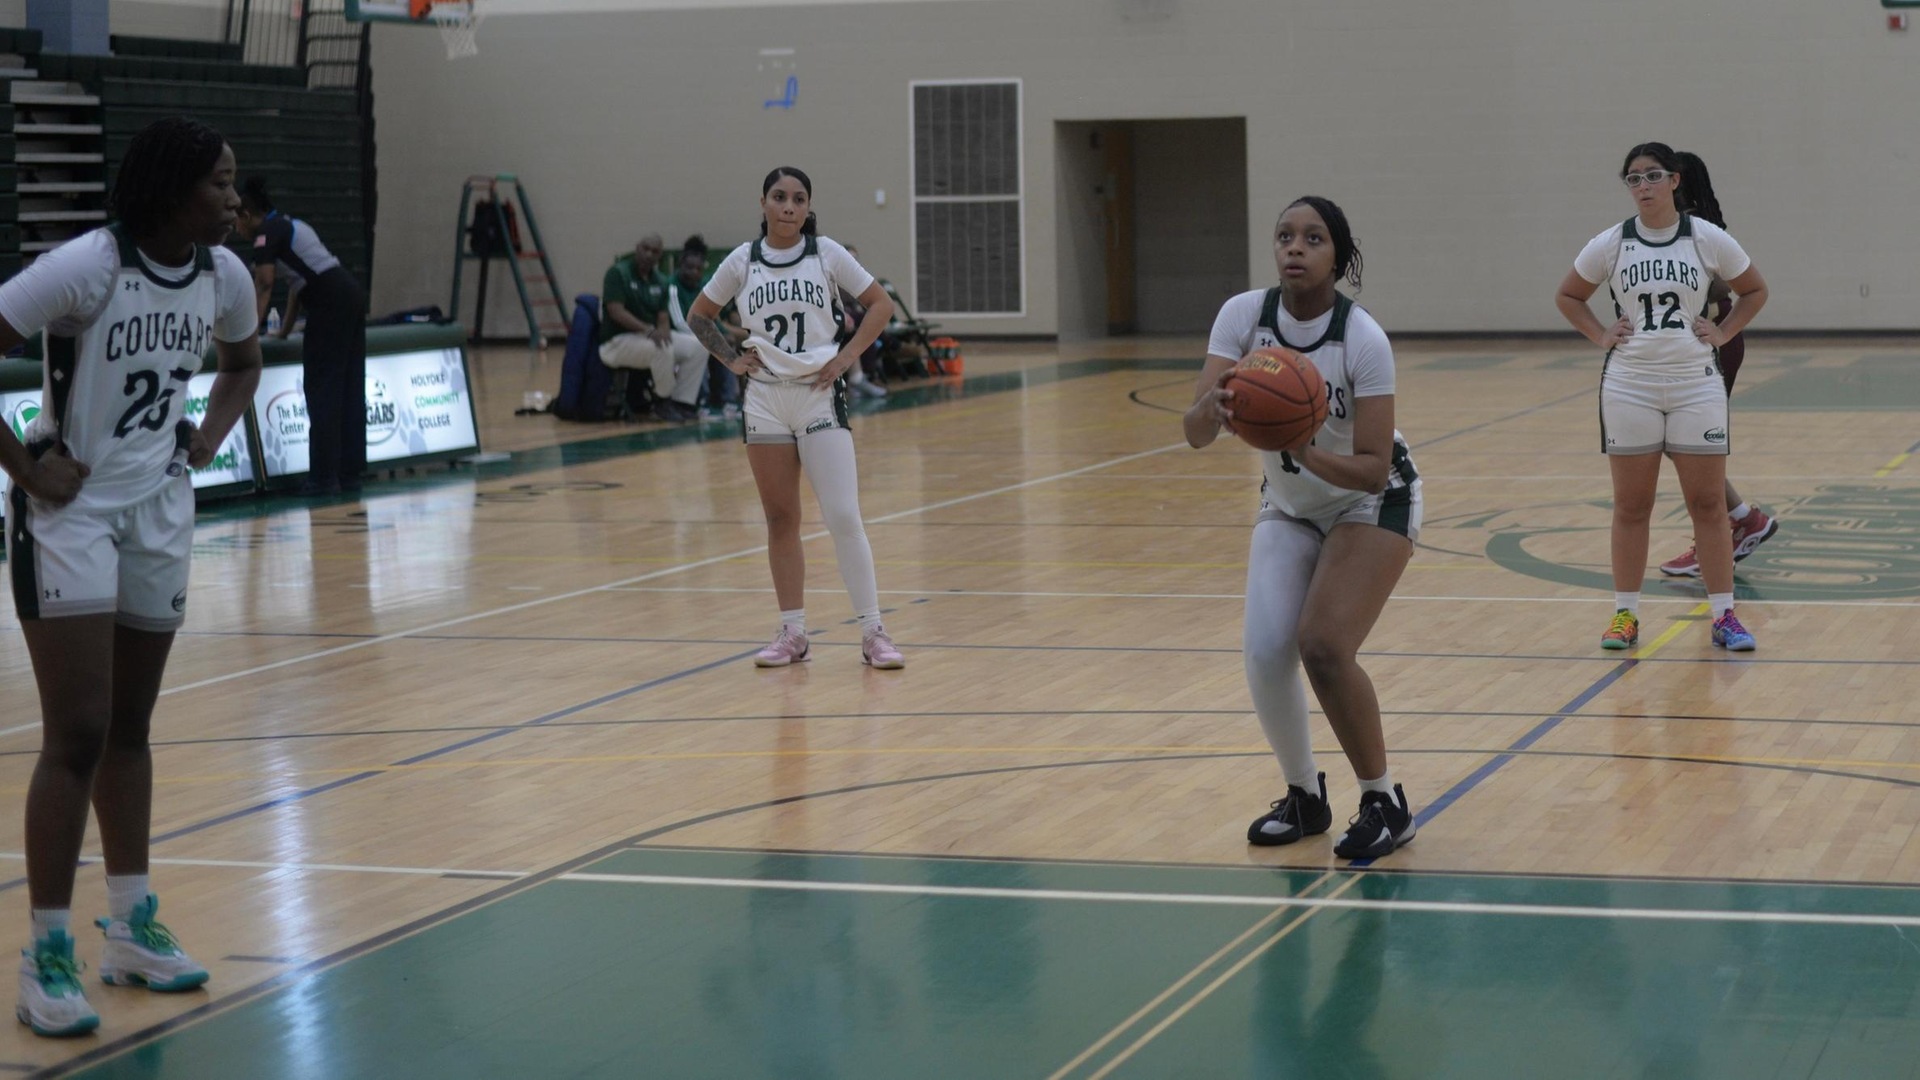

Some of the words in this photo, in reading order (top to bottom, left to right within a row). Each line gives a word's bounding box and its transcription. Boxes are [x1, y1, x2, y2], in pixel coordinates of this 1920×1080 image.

[1620, 259, 1699, 293] COUGARS
[748, 278, 825, 316] COUGARS
[1638, 291, 1685, 331] 12
[763, 311, 807, 355] 21
[410, 373, 447, 388] HOLYOKE
[112, 366, 194, 440] 25
[414, 391, 461, 408] COMMUNITY
[277, 404, 291, 420] The
[366, 402, 395, 426] GARS
[418, 412, 452, 430] COLLEGE
[279, 421, 305, 436] Center
